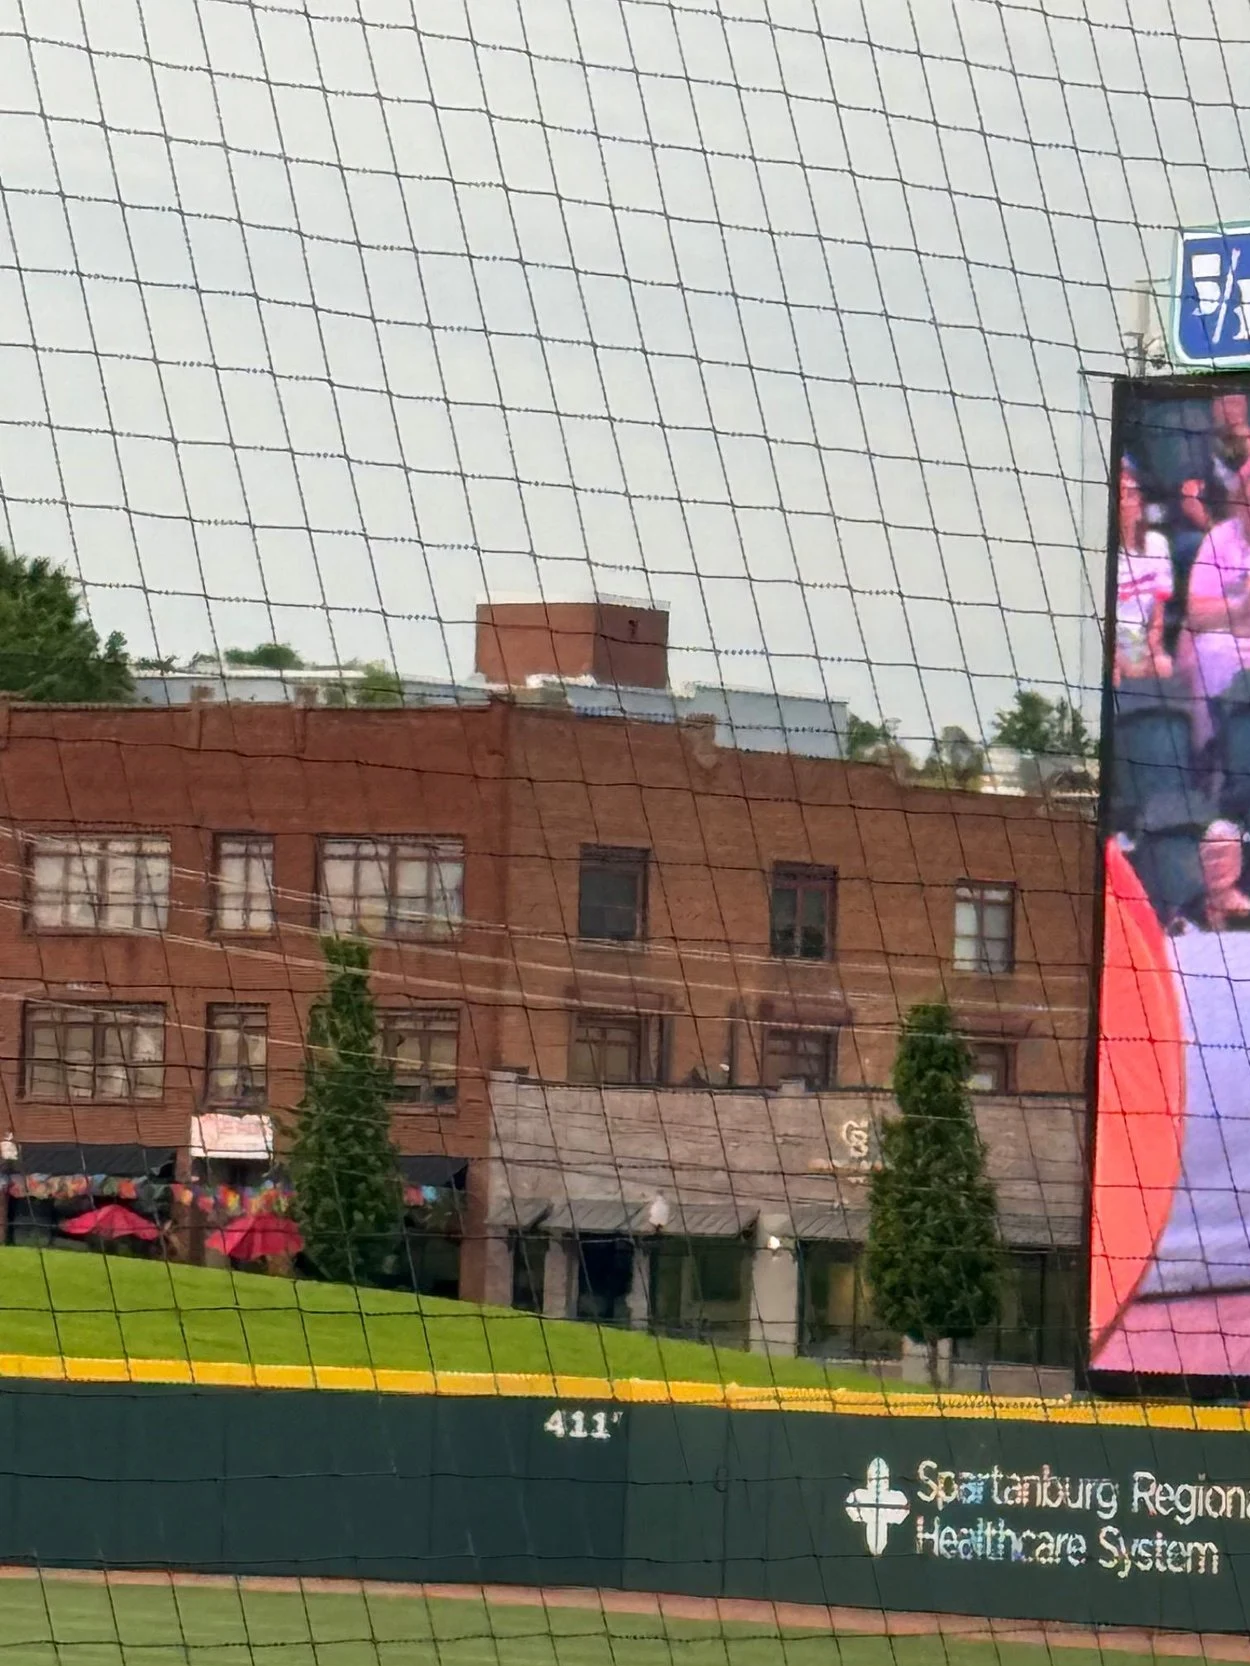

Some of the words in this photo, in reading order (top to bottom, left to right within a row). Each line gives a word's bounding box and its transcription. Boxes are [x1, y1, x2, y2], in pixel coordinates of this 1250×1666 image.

[916, 1459, 1119, 1518] Spartanburg
[914, 1515, 1087, 1567] Healthcare
[1097, 1526, 1220, 1578] System
